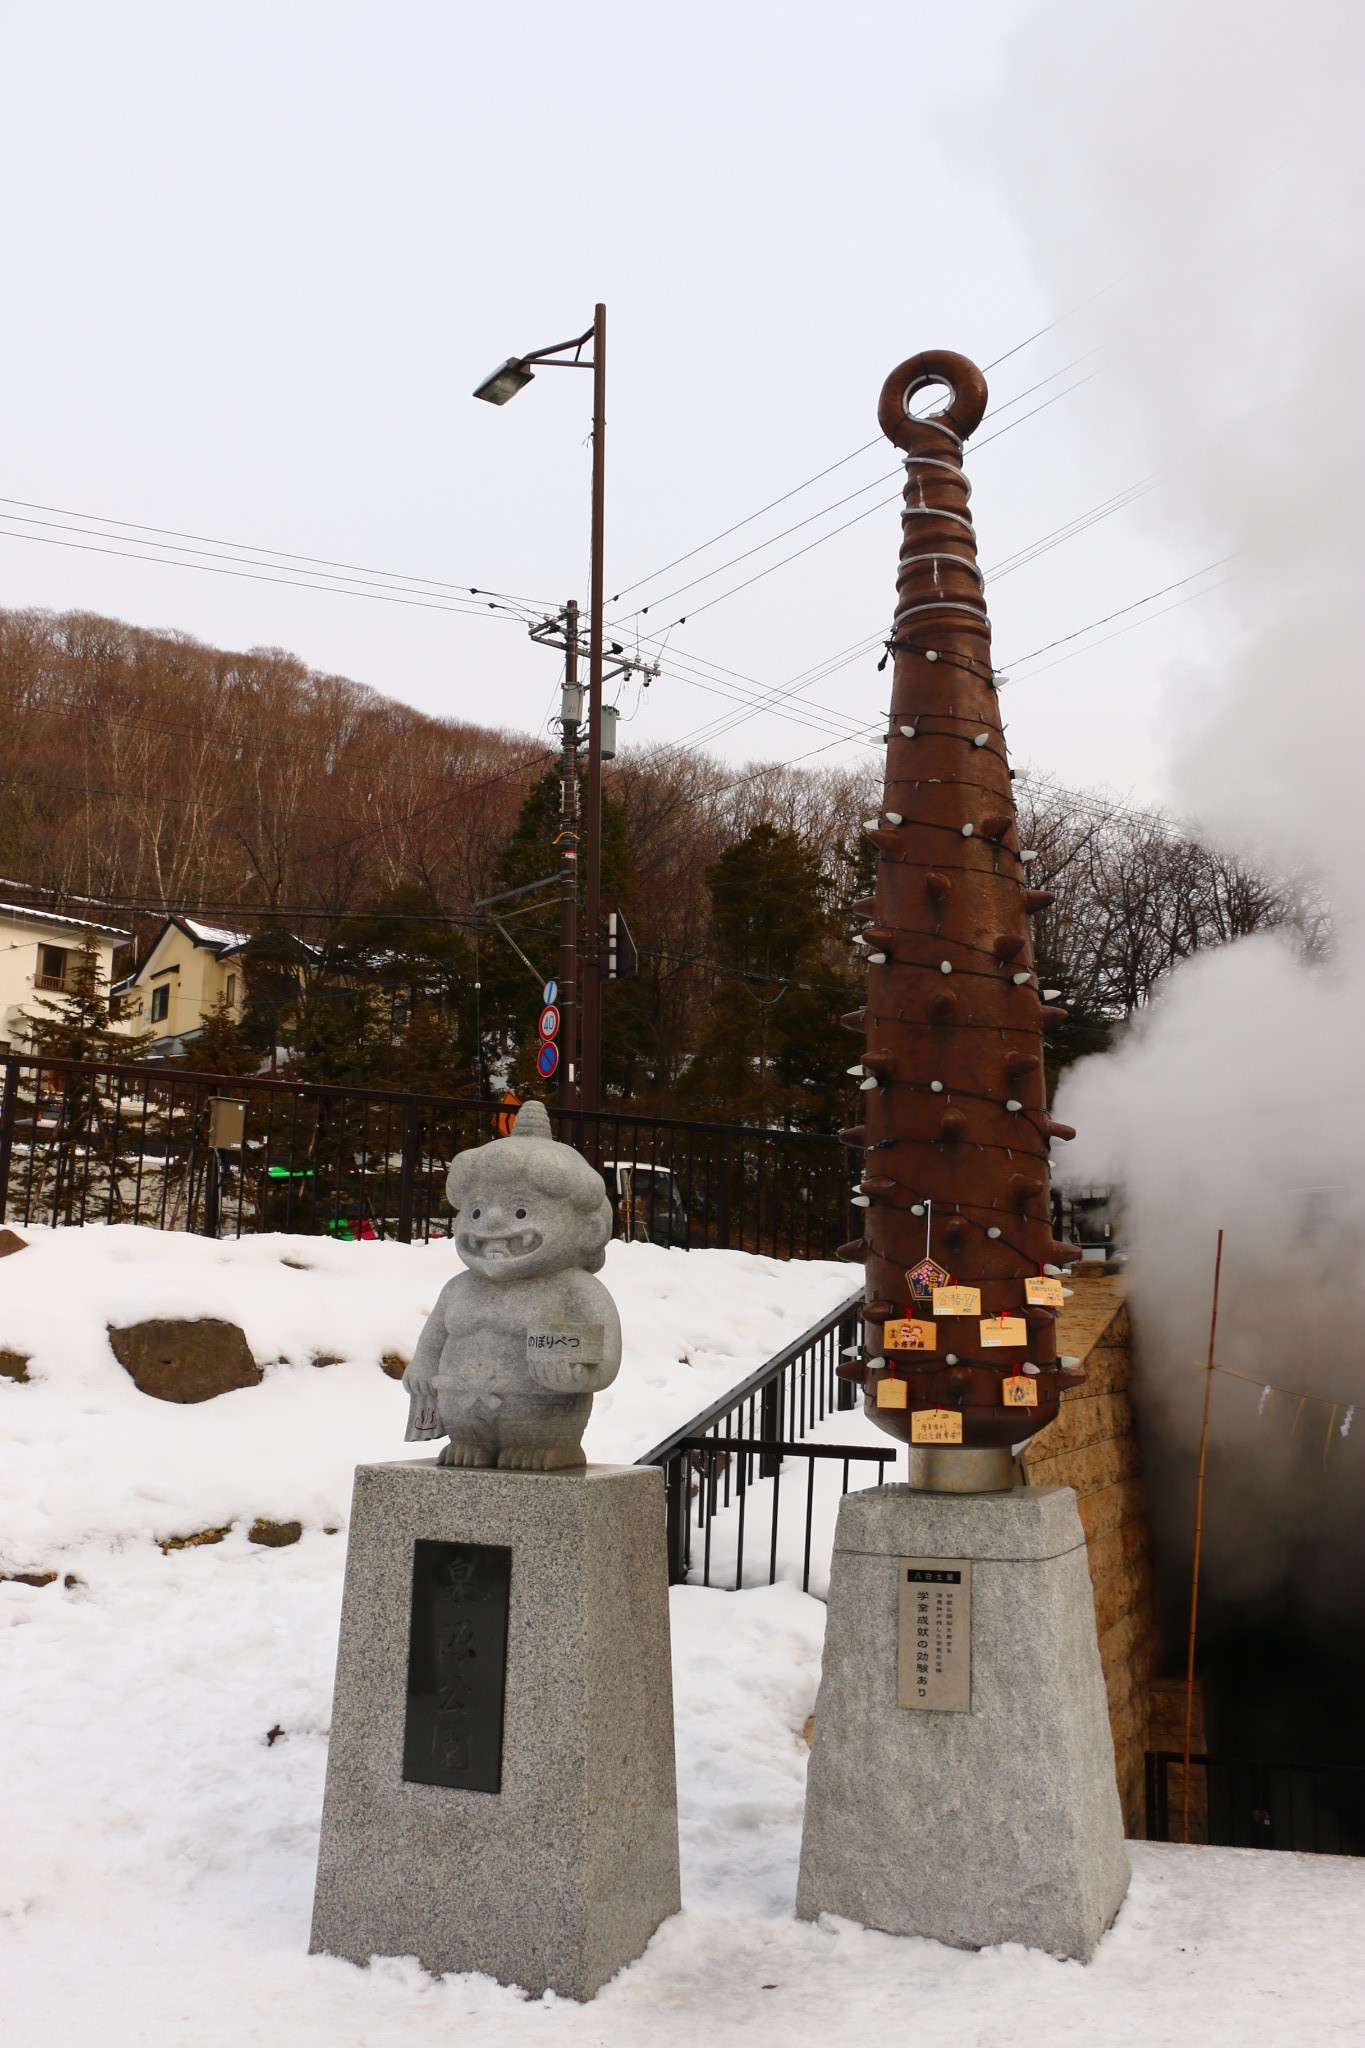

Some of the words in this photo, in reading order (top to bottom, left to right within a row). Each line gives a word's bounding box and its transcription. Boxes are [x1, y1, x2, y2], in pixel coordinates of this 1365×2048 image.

[543, 1015, 555, 1030] 40
[527, 1335, 580, 1349] のぼりべつ
[893, 1340, 925, 1348] 合格祈願
[914, 1572, 954, 1581] 八白土星
[917, 1591, 929, 1697] 学業成就の効験あり
